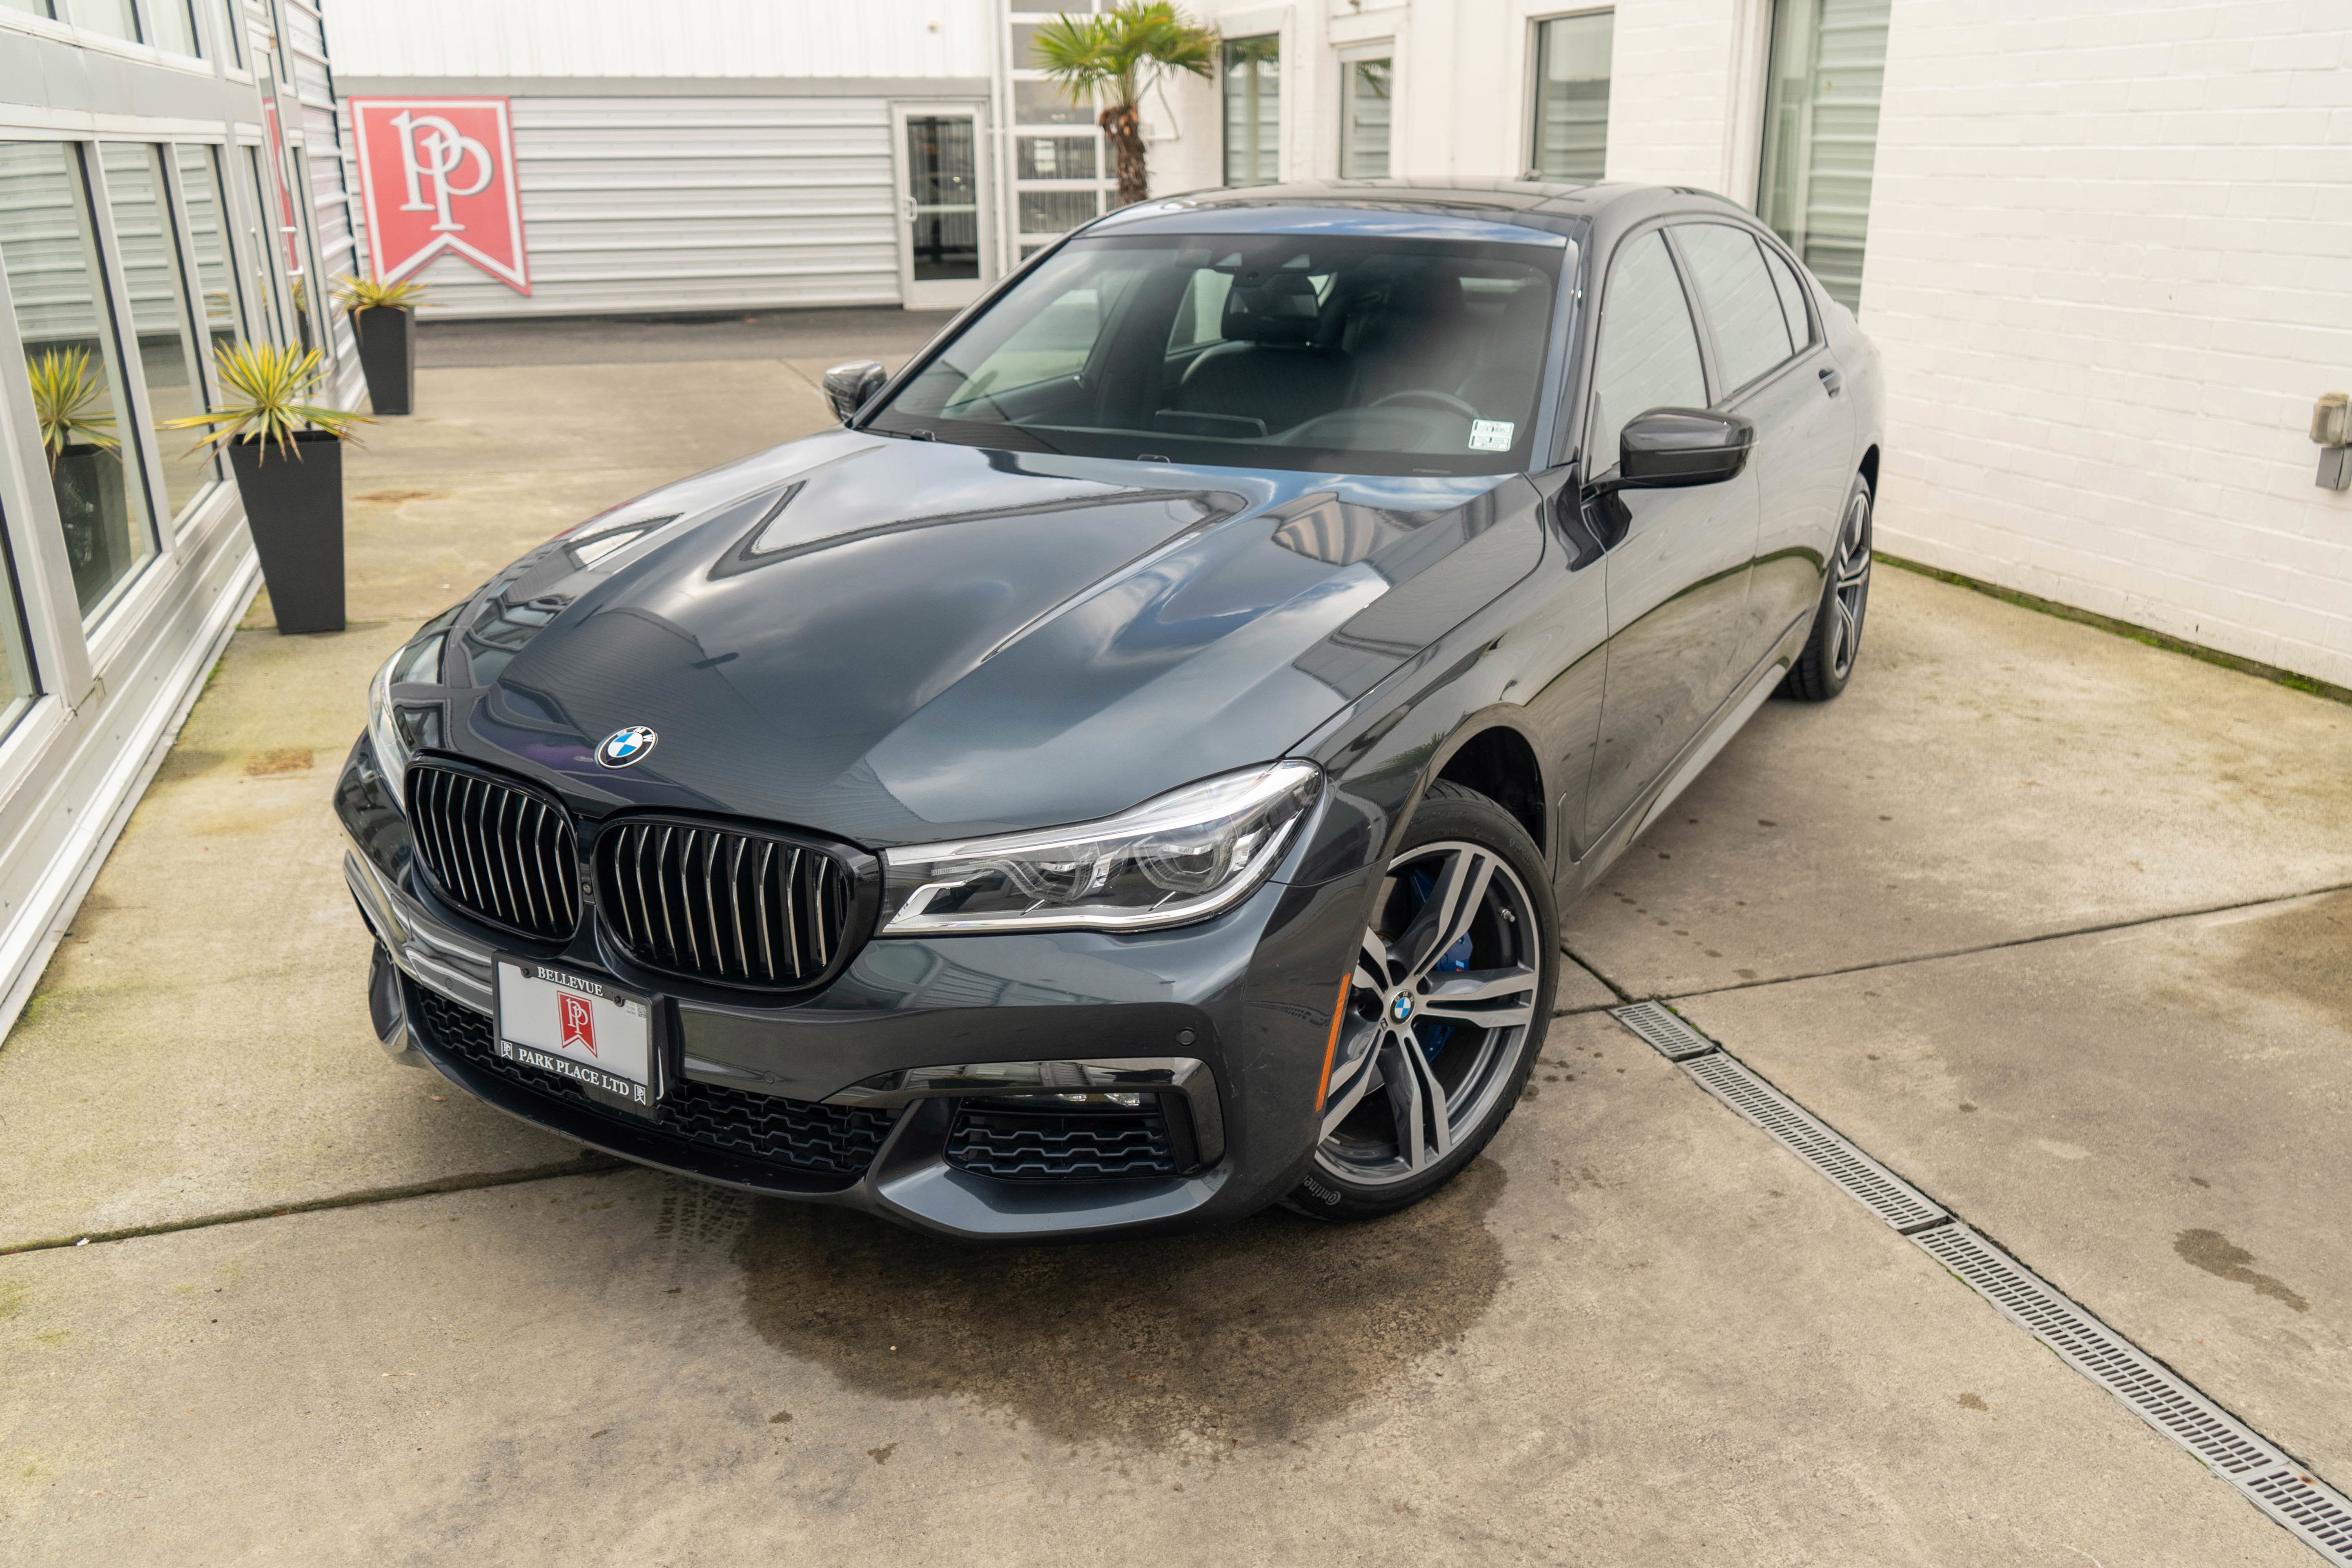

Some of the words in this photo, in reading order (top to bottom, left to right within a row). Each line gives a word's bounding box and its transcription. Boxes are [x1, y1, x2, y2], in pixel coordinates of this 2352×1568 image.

[537, 966, 603, 996] BELLEVUE
[1394, 991, 1414, 1002] BMW
[518, 1048, 554, 1070] PARK
[556, 1059, 599, 1085] PLACE
[602, 1075, 629, 1095] LTD
